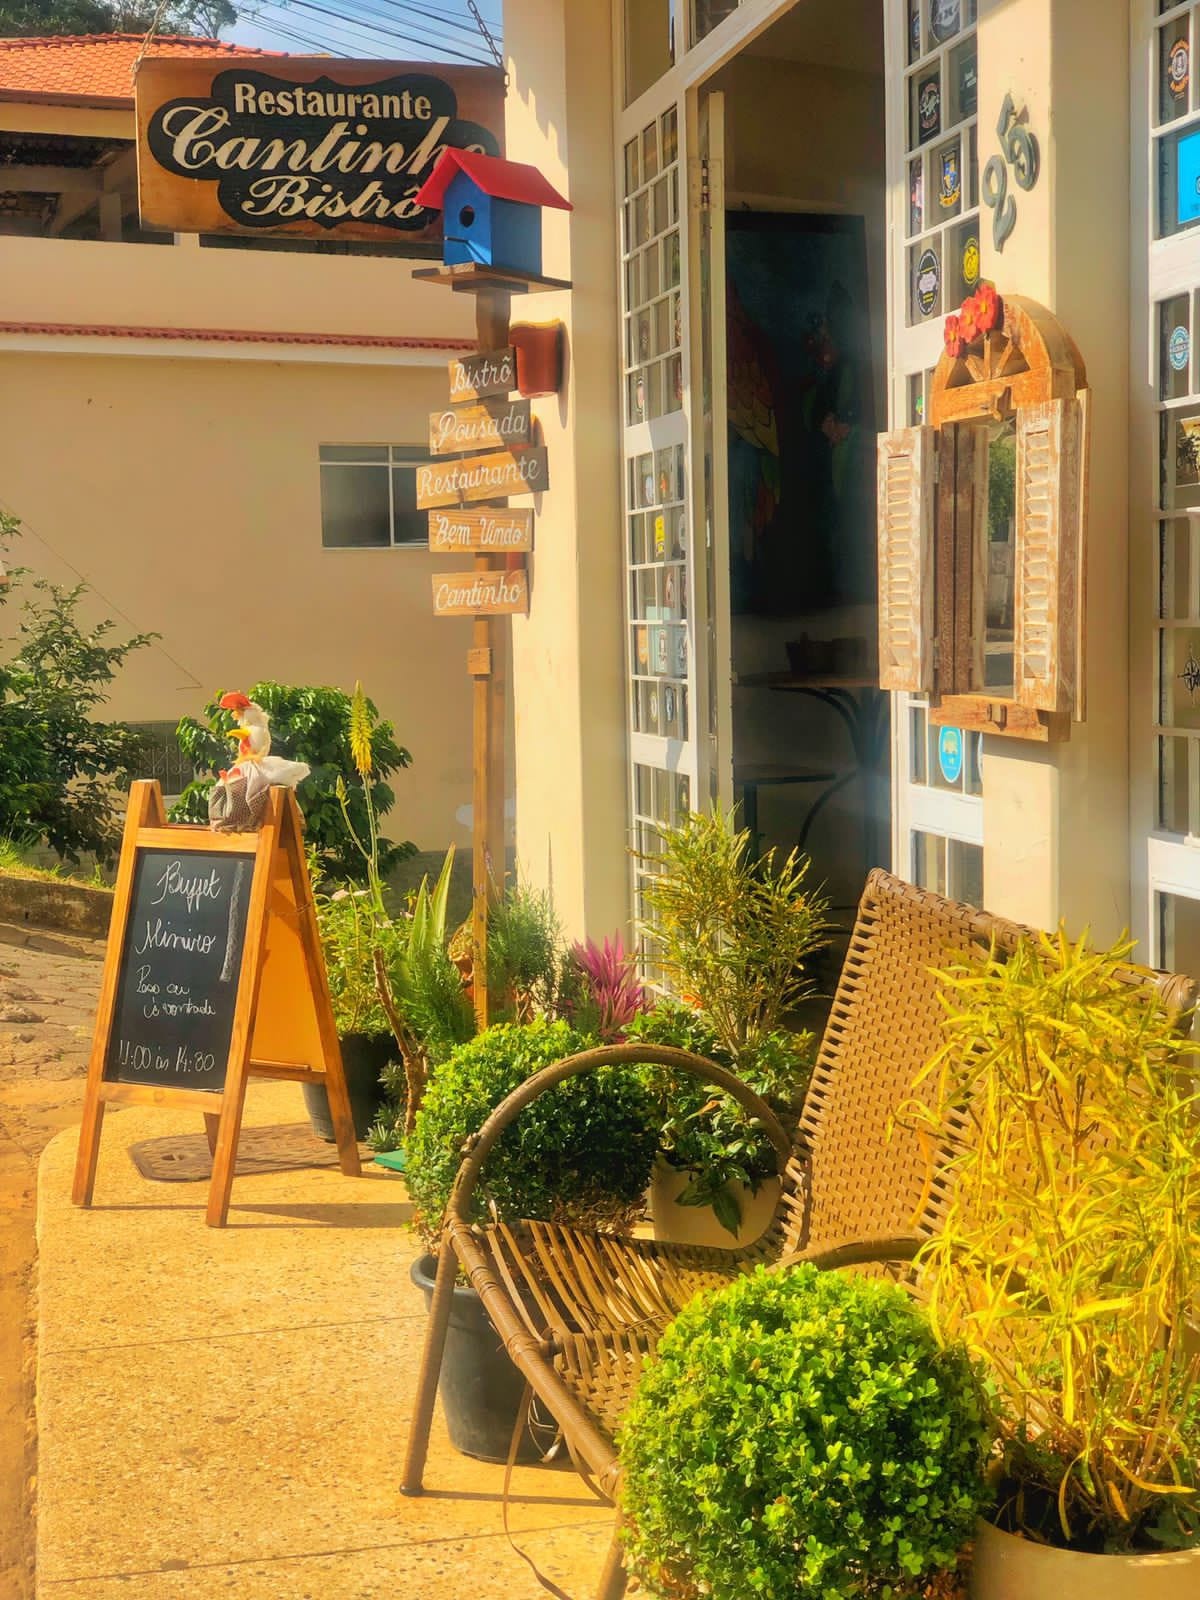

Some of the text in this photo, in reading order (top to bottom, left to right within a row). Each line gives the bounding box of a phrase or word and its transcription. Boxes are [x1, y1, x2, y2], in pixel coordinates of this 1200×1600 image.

[234, 83, 432, 120] Restaurante
[433, 405, 527, 449] Pousada
[419, 456, 538, 498] Restaurante
[436, 514, 530, 546] Bem Vindo!
[435, 576, 522, 611] Cantinho
[151, 861, 222, 914] Buffet
